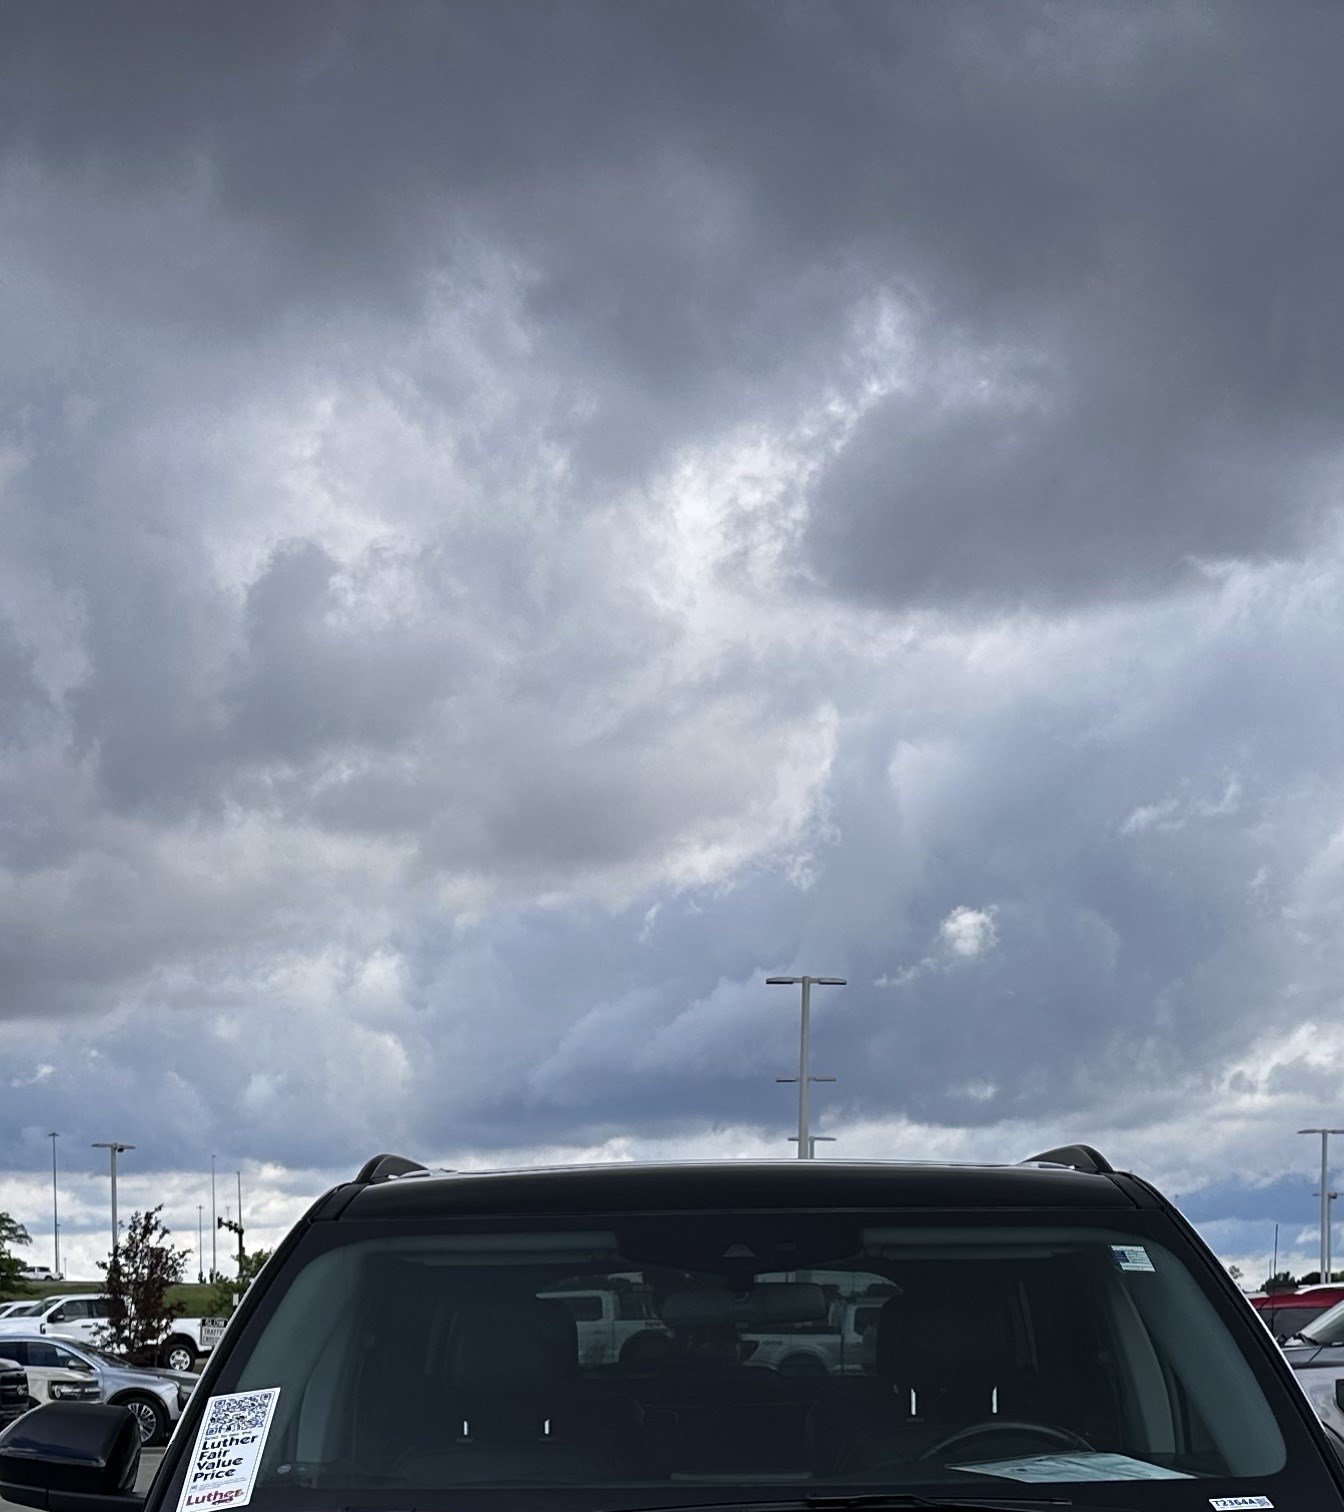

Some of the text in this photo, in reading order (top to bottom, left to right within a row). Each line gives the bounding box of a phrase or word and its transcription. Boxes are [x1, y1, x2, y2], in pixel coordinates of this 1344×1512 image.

[201, 1434, 259, 1451] Luther
[198, 1448, 230, 1462] Fair
[196, 1457, 244, 1471] Value
[192, 1468, 237, 1483] Price
[186, 1488, 244, 1506] Luther
